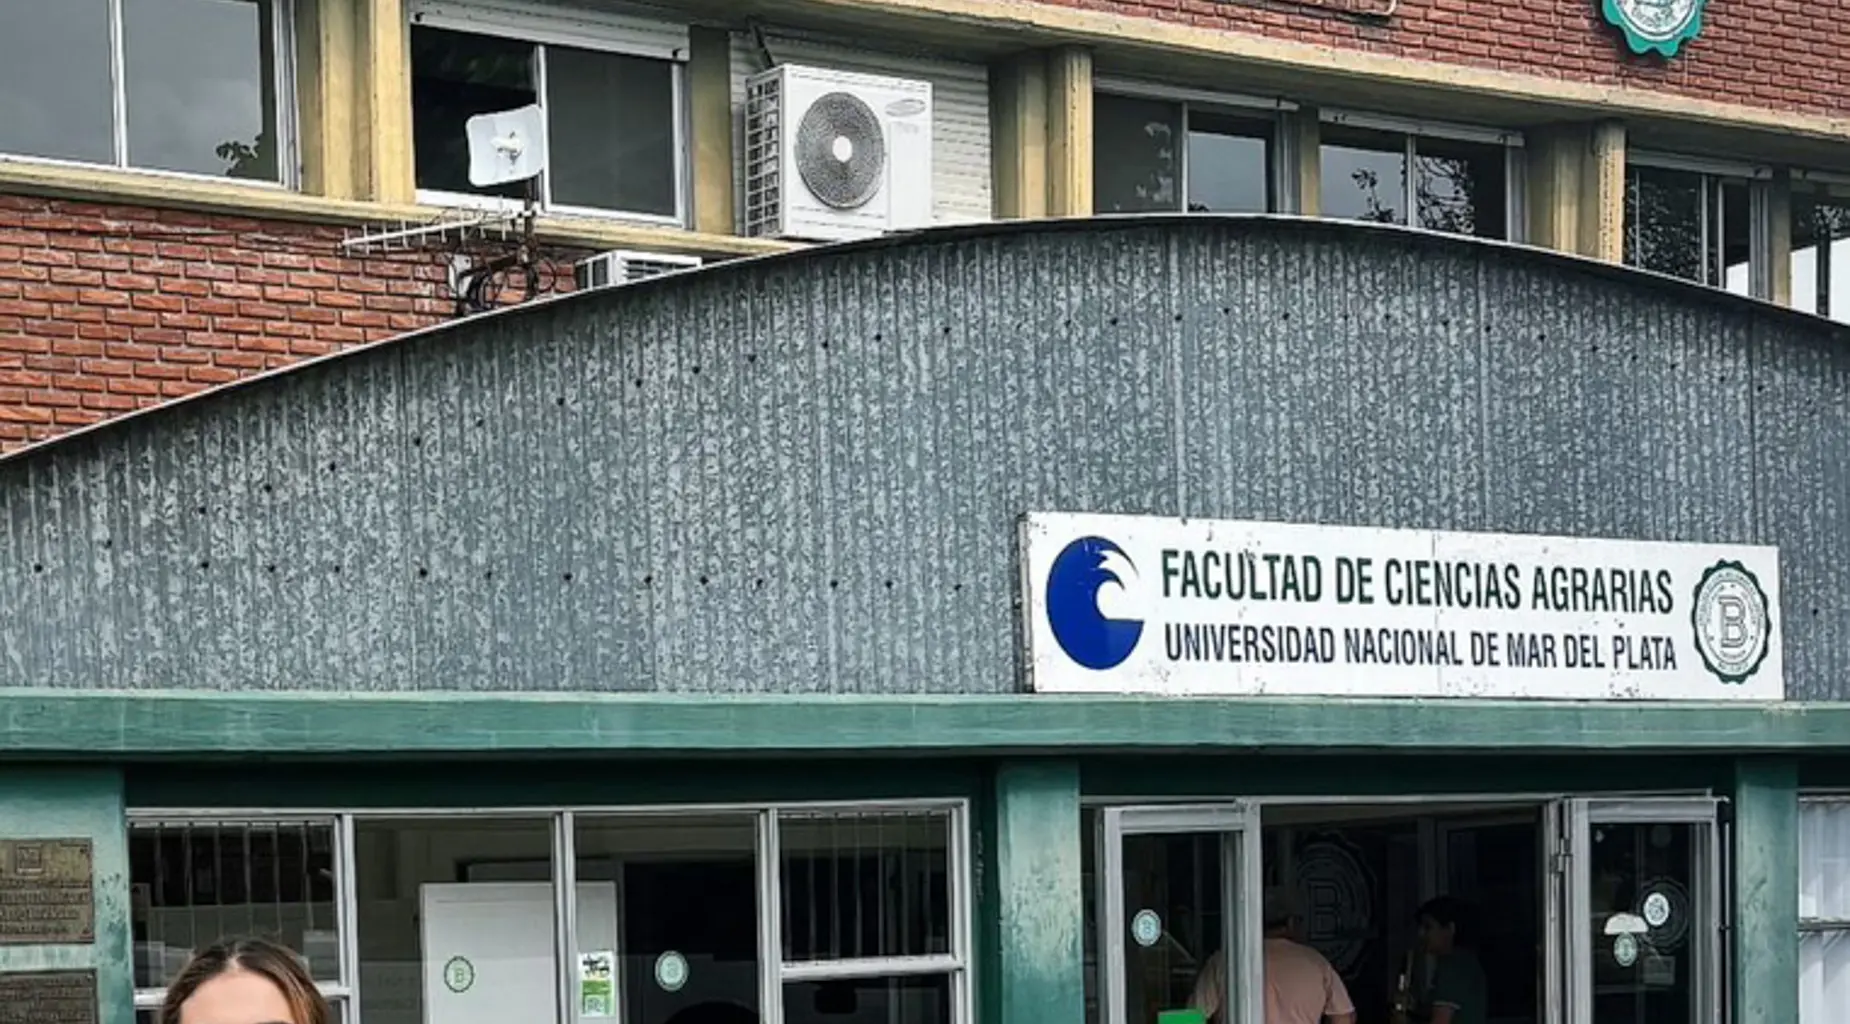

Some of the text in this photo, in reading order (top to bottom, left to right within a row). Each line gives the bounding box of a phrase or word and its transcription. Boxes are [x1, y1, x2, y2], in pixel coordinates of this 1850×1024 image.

[1161, 549, 1322, 602] FACULTAD
[1335, 556, 1374, 604] DE
[1385, 558, 1521, 609] CIENCIAS
[1532, 566, 1674, 614] AGRARIAS
[1165, 622, 1336, 663] UNIVERSIDAD
[1344, 627, 1464, 666] NACIONAL
[1470, 631, 1501, 667] DE
[1507, 632, 1557, 668] MAR
[1564, 633, 1605, 668] DEL
[1613, 635, 1679, 670] PLATA
[1718, 595, 1748, 648] B
